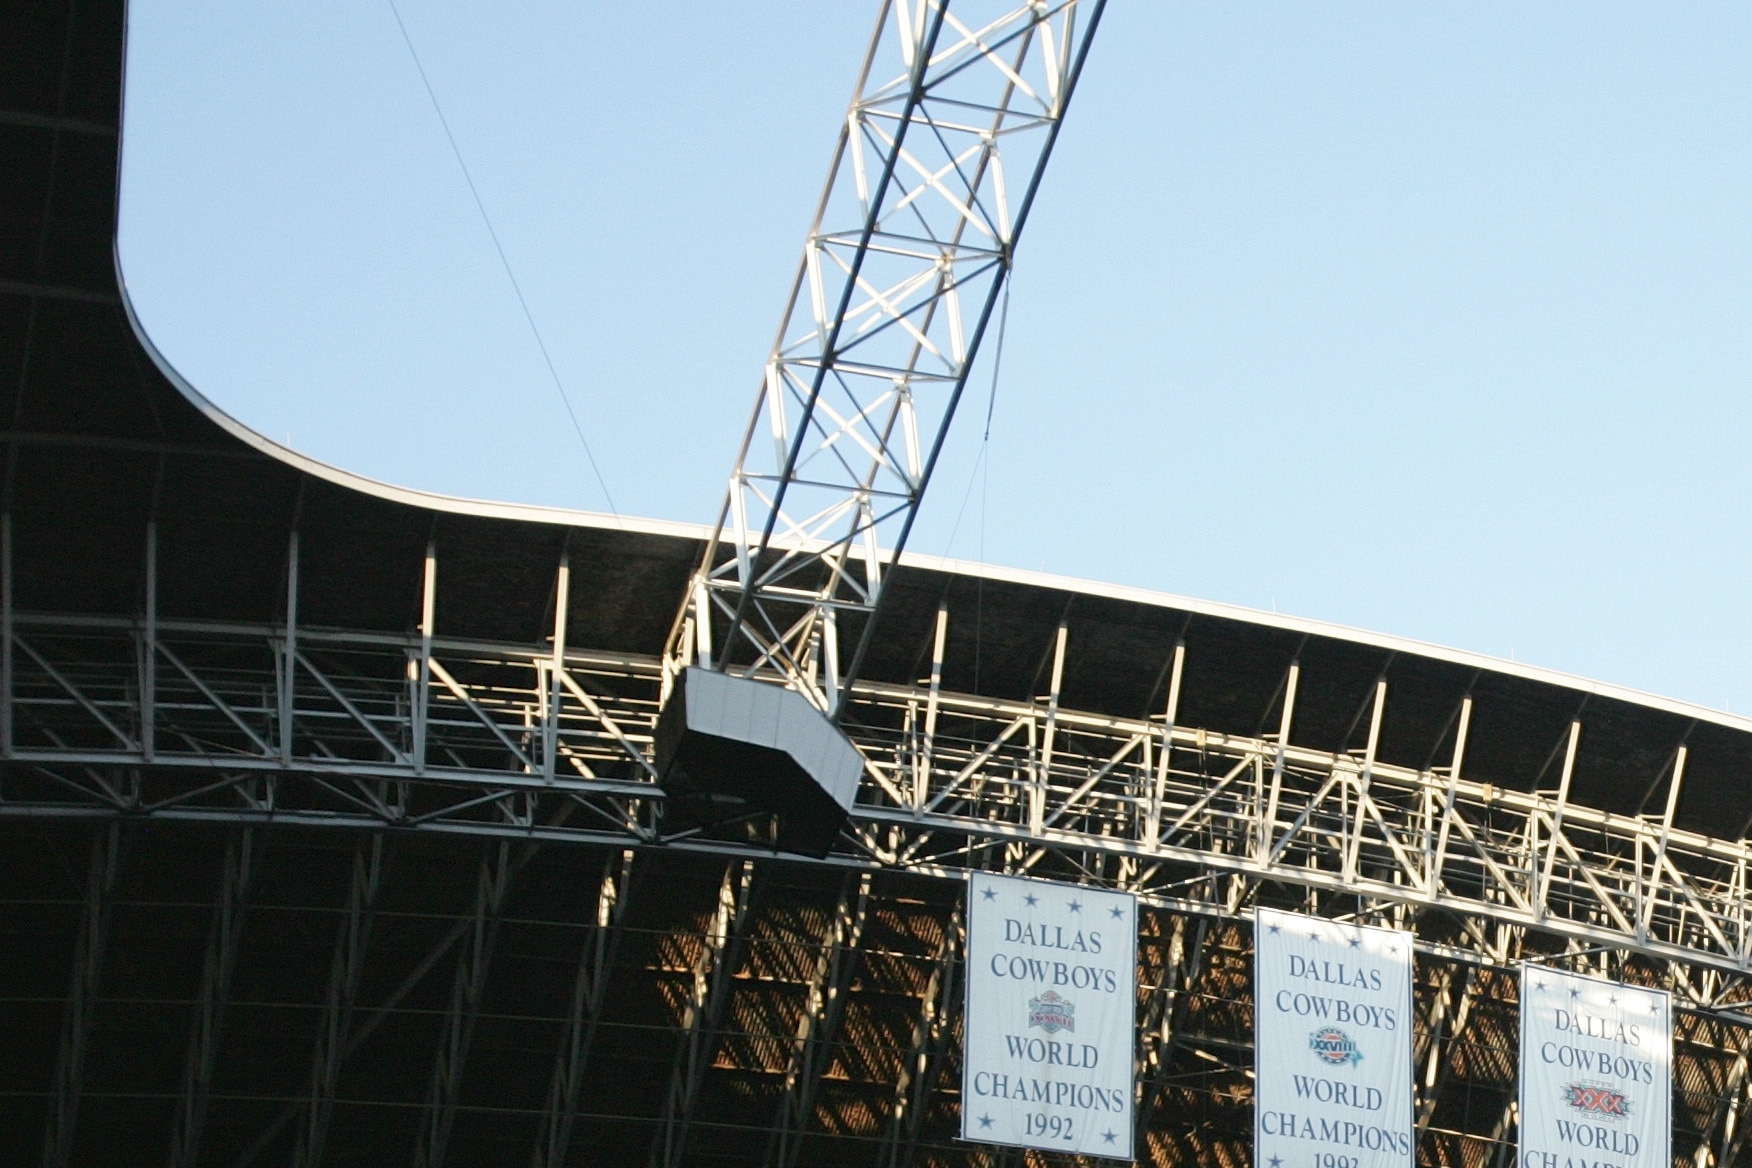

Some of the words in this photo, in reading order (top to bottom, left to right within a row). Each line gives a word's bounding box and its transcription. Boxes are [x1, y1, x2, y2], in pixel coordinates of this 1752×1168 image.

[1004, 917, 1102, 955] DALLAS
[989, 952, 1117, 994] COWBOYS
[1288, 954, 1383, 992] DALLAS
[1275, 989, 1397, 1032] COWBOYS
[1554, 1008, 1641, 1047] DALLAS
[1004, 1034, 1100, 1071] WORLD
[1540, 1041, 1653, 1085] COWBOYS
[973, 1070, 1125, 1114] CHAMPIONS
[1293, 1074, 1383, 1112] WORLD
[1570, 1086, 1625, 1117] XXX
[1023, 1112, 1075, 1142] 1992
[1261, 1110, 1410, 1157] CHAMPIONS
[1556, 1118, 1640, 1157] WORLD
